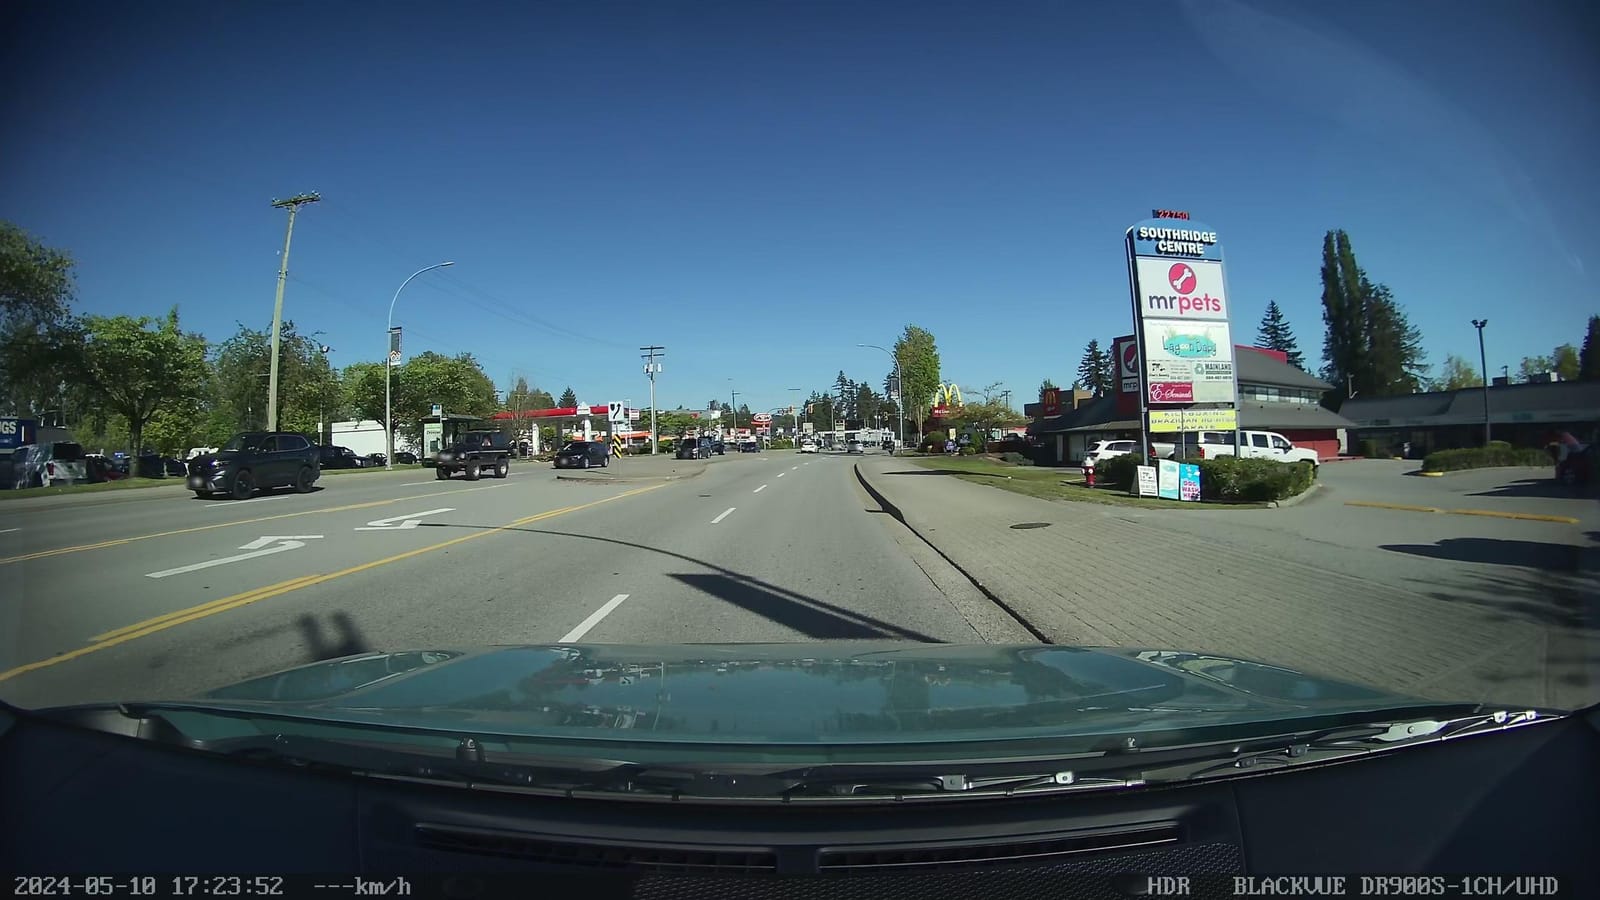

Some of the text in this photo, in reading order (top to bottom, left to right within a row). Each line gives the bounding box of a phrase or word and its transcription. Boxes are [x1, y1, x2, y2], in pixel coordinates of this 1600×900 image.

[1157, 209, 1190, 221] 22750
[1139, 226, 1217, 243] SOUTHRIDGE
[1158, 240, 1205, 254] CENTRE
[1149, 293, 1221, 314] mrpets
[1123, 382, 1138, 390] mrp
[0, 421, 17, 434] GS
